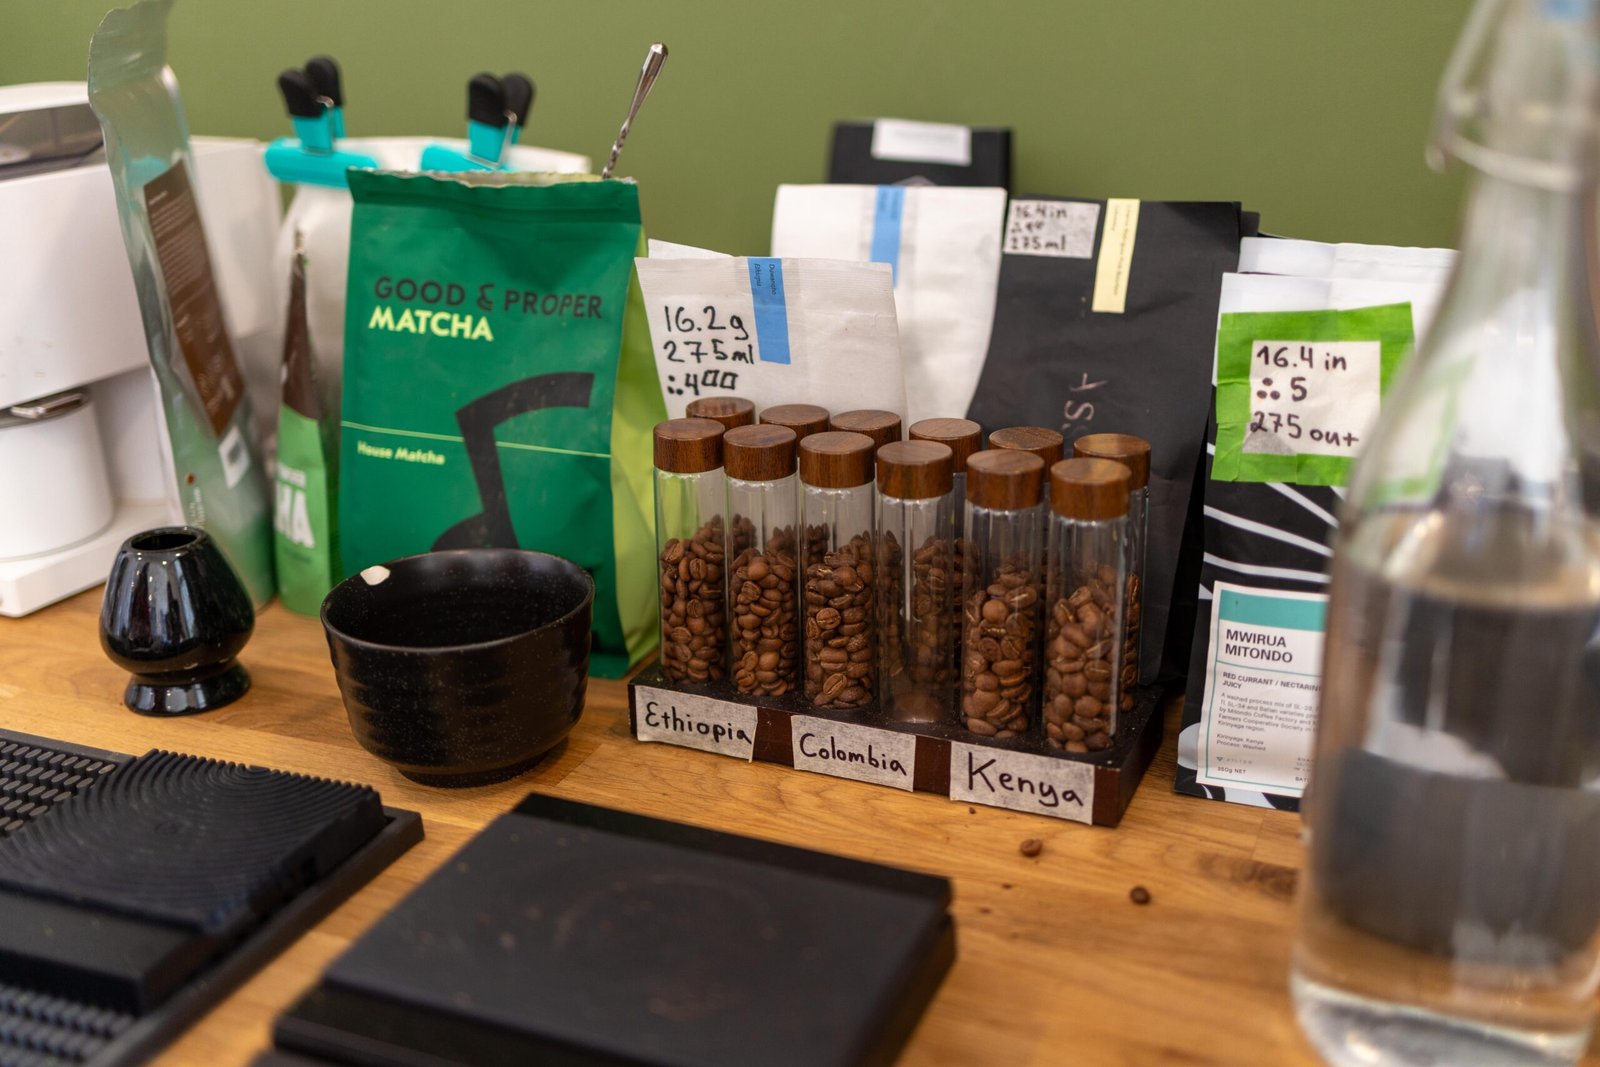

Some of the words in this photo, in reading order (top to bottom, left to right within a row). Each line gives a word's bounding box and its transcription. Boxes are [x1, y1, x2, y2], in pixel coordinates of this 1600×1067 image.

[374, 276, 466, 307] GOOD
[476, 283, 495, 311] &
[503, 289, 603, 319] PROPER
[368, 305, 494, 342] MATCHA
[664, 305, 749, 340] 16.2g
[1256, 345, 1314, 368] 16.4
[1324, 352, 1347, 371] in
[1250, 411, 1302, 439] 275
[357, 440, 393, 459] House
[395, 446, 445, 465] Matcha
[1226, 628, 1287, 648] MWIRUA
[1225, 643, 1293, 663] MITONDO
[1222, 680, 1242, 690] JUICY
[1223, 671, 1237, 681] RED
[1238, 673, 1274, 686] CURRANT
[644, 701, 753, 745] Ethiopia
[799, 733, 907, 777] Colombia
[967, 751, 1084, 807] Kenya
